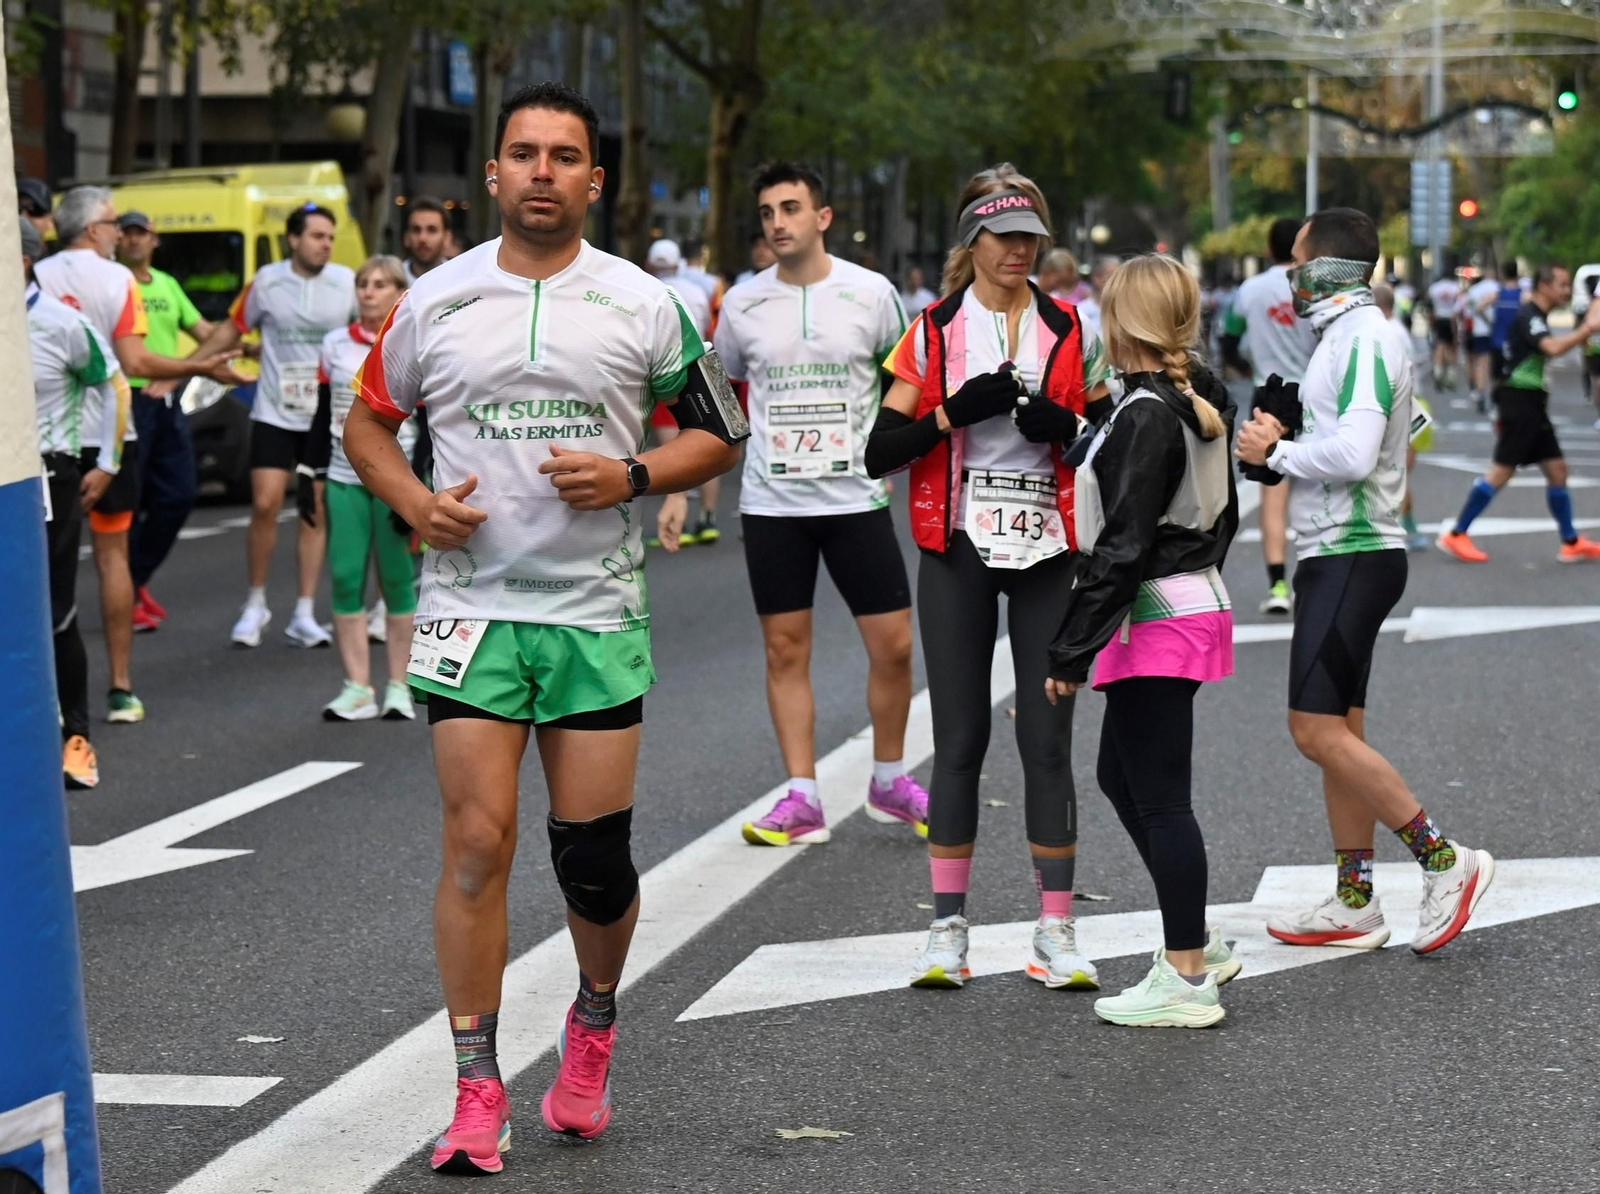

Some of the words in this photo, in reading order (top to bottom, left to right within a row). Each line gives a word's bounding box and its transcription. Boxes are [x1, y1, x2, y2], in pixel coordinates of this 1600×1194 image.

[583, 290, 611, 306] SIG
[611, 302, 637, 318] Laboral
[788, 363, 850, 377] SUBIDA
[775, 381, 797, 391] LAS
[800, 379, 849, 390] ERMITAS
[462, 404, 499, 422] XII
[508, 399, 610, 421] SUBIDA
[474, 425, 485, 439] A
[491, 425, 522, 440] LAS
[526, 423, 604, 440] ERMITAS
[791, 429, 823, 453] 72
[991, 508, 1044, 540] 143
[520, 579, 574, 589] IMDECO
